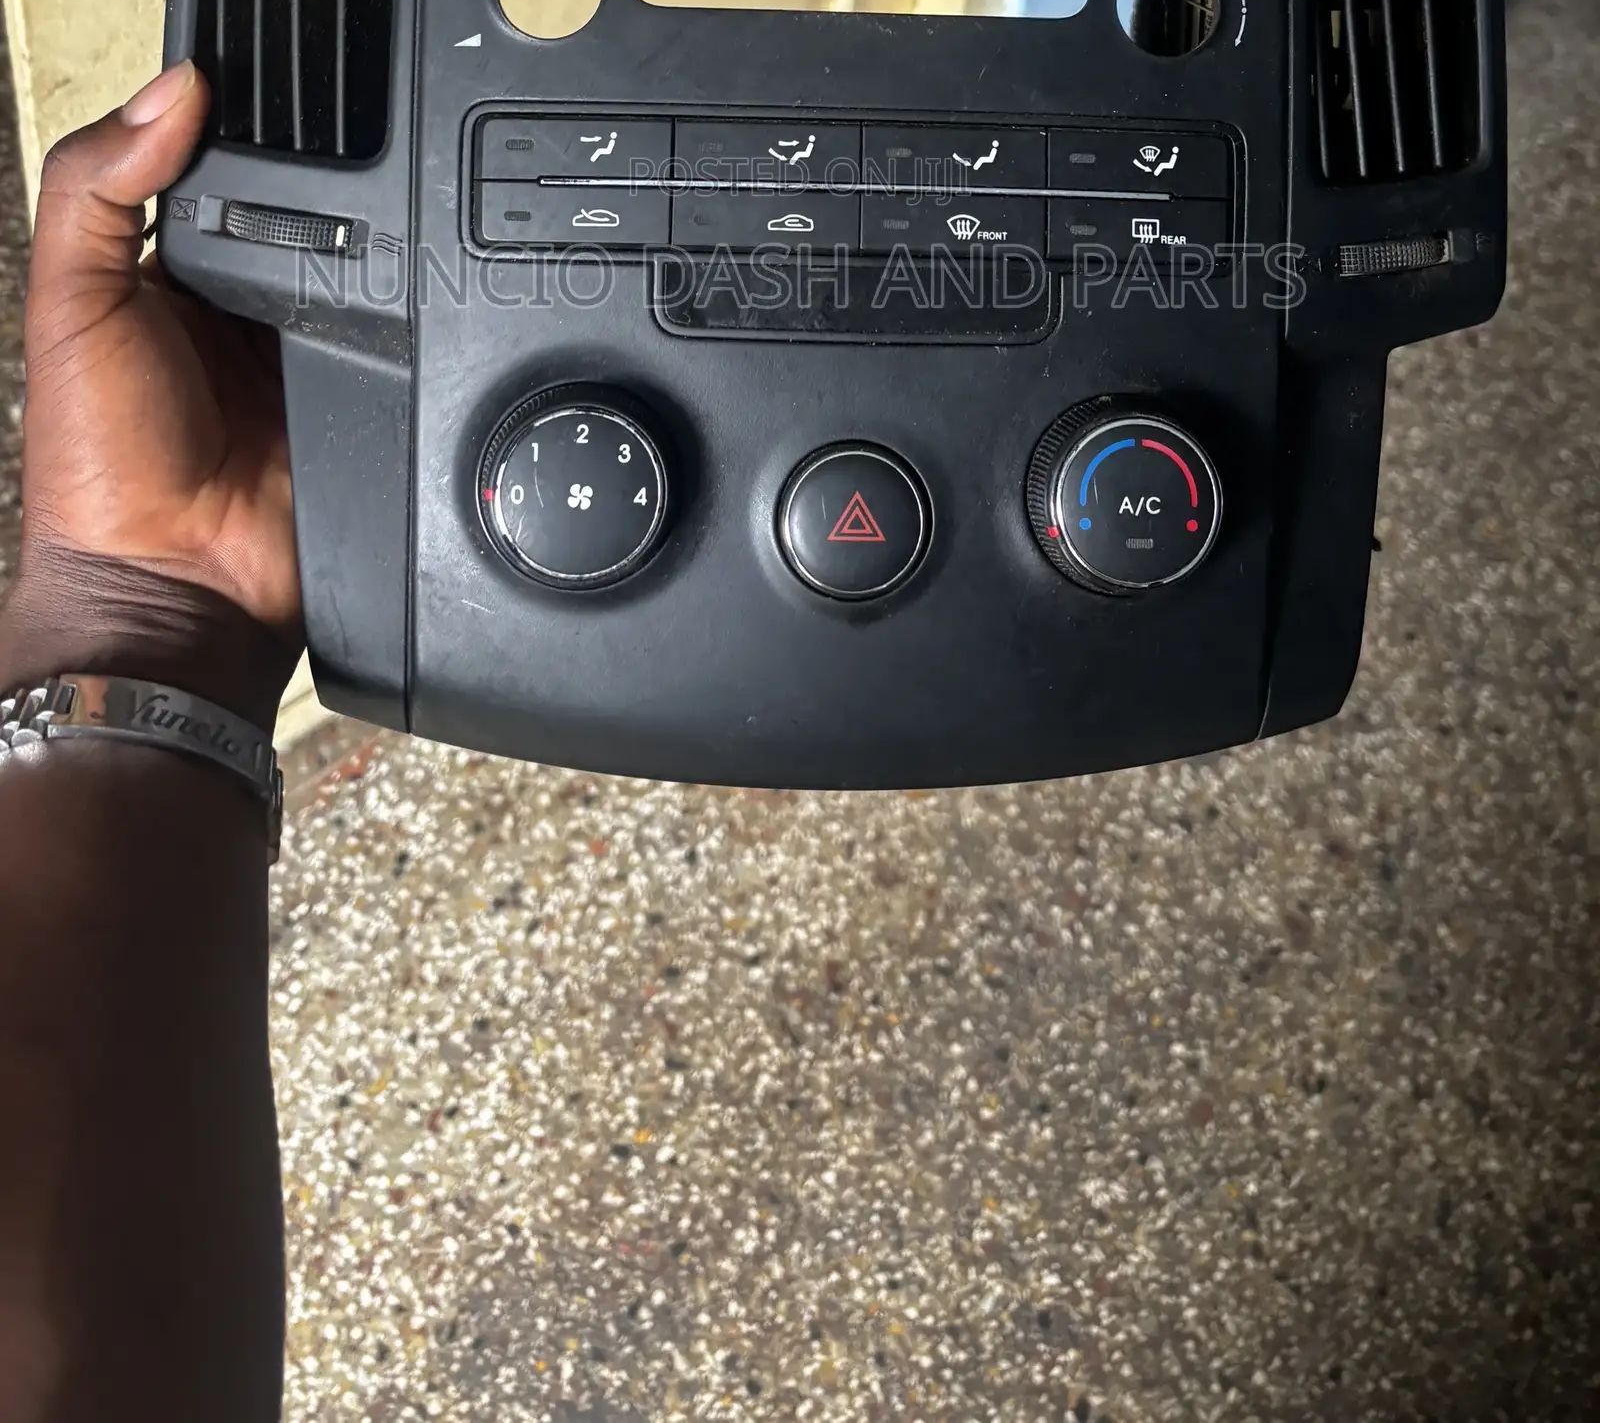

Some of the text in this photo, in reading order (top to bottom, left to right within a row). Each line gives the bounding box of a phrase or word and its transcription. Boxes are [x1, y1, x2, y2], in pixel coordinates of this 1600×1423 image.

[977, 231, 1008, 241] FRONT
[1160, 235, 1187, 245] REAR
[510, 423, 648, 506] 0 1 2 3 4
[1118, 495, 1161, 517] A/C
